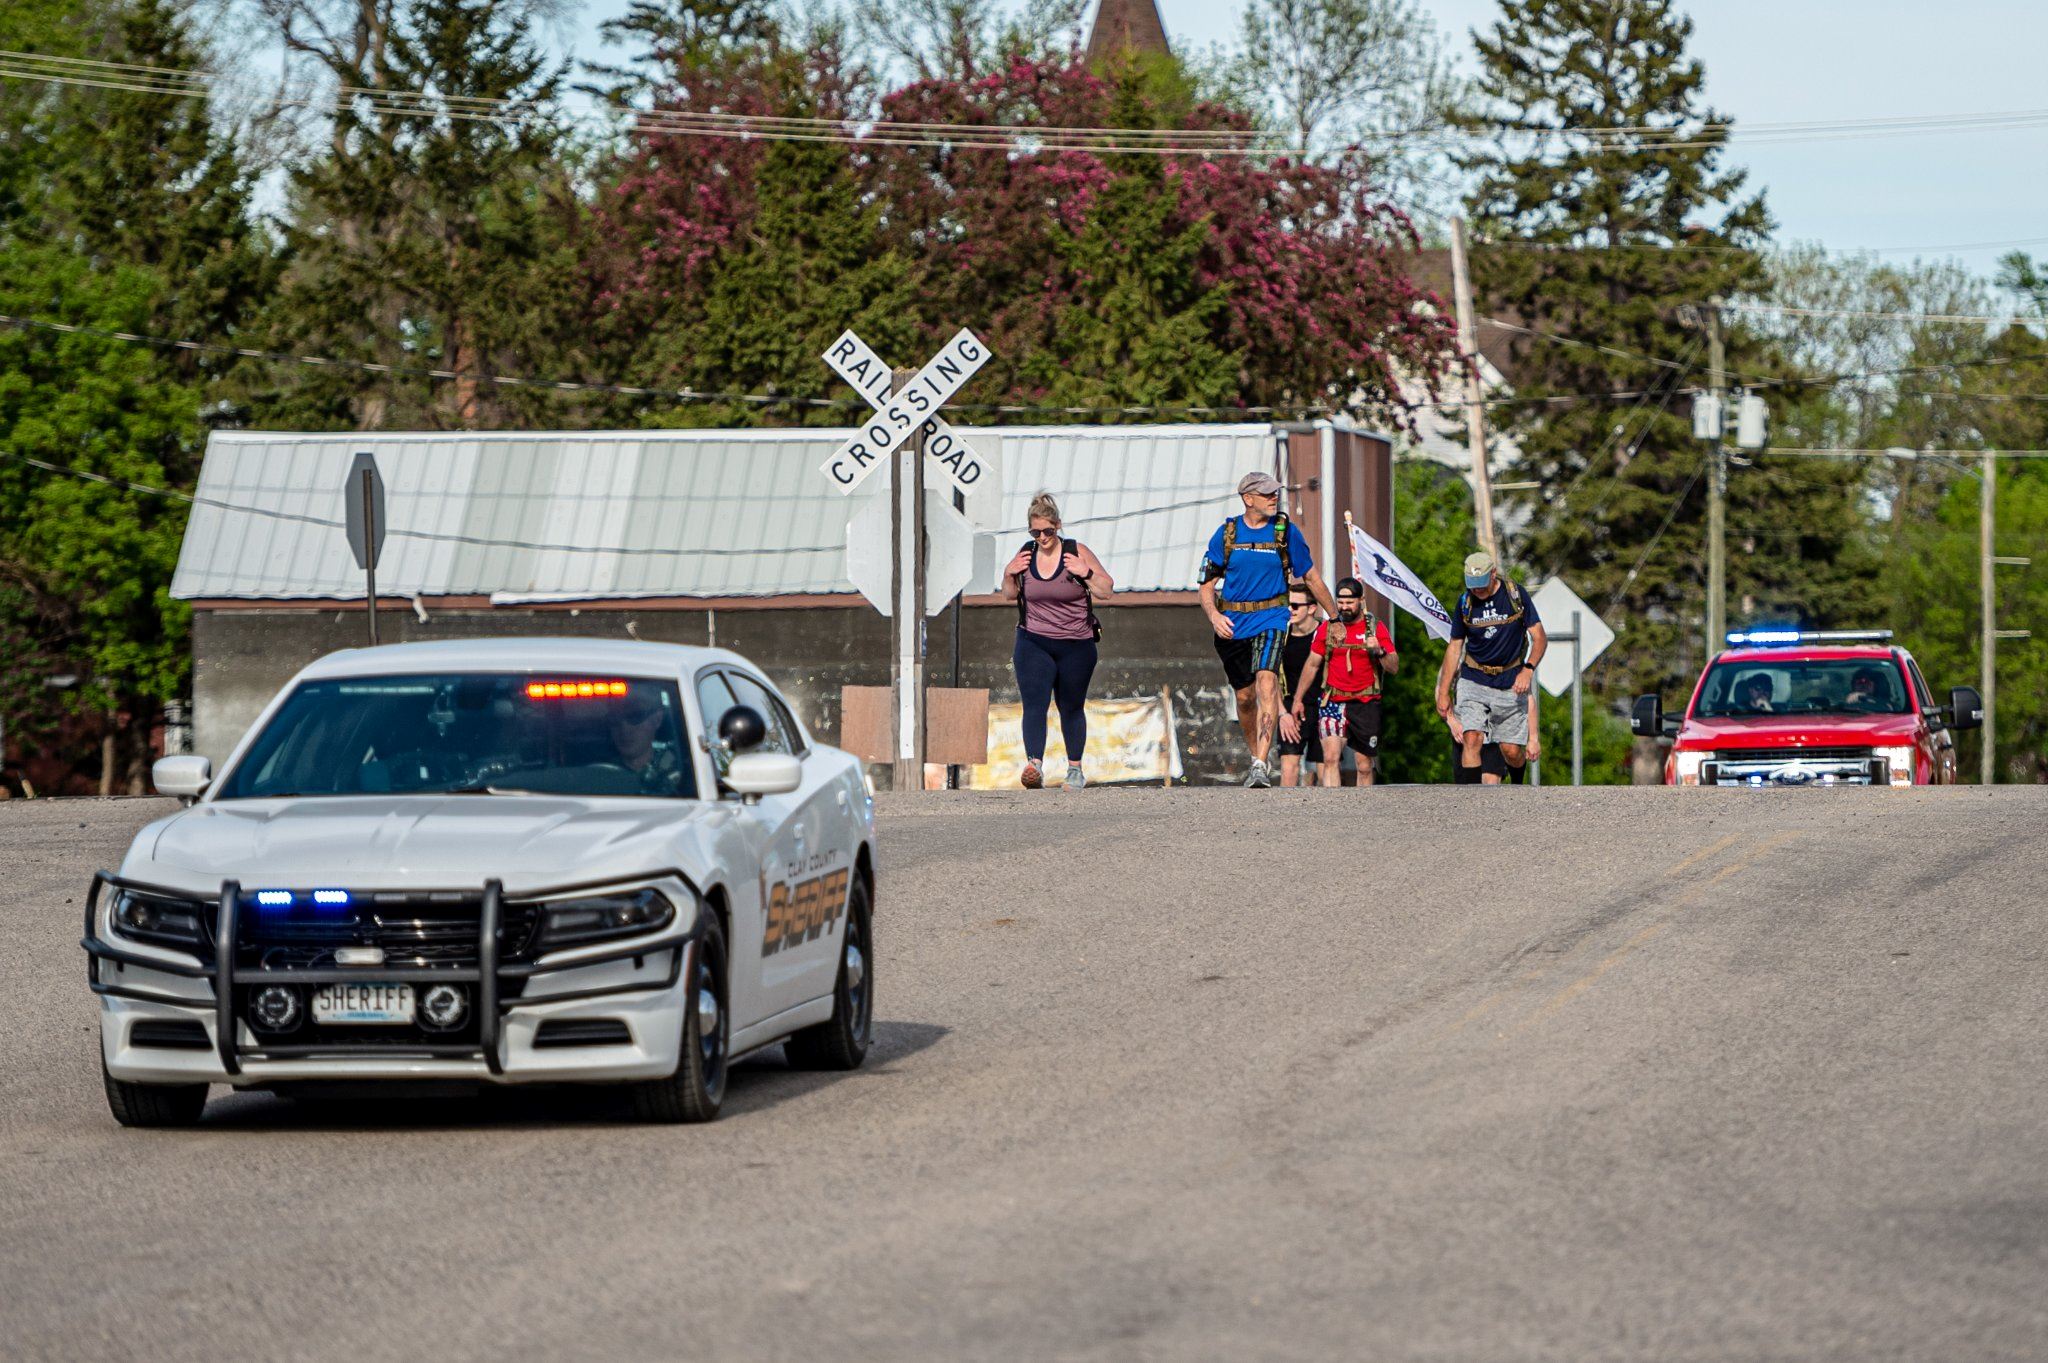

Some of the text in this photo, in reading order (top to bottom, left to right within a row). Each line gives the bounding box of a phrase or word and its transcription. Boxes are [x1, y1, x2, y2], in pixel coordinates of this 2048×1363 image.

[831, 338, 891, 406] RAIL
[831, 340, 980, 485] CROSSING
[788, 848, 838, 878] CLAY COUNTY
[761, 866, 849, 959] SHERIFF
[319, 986, 409, 1010] SHERIFF
